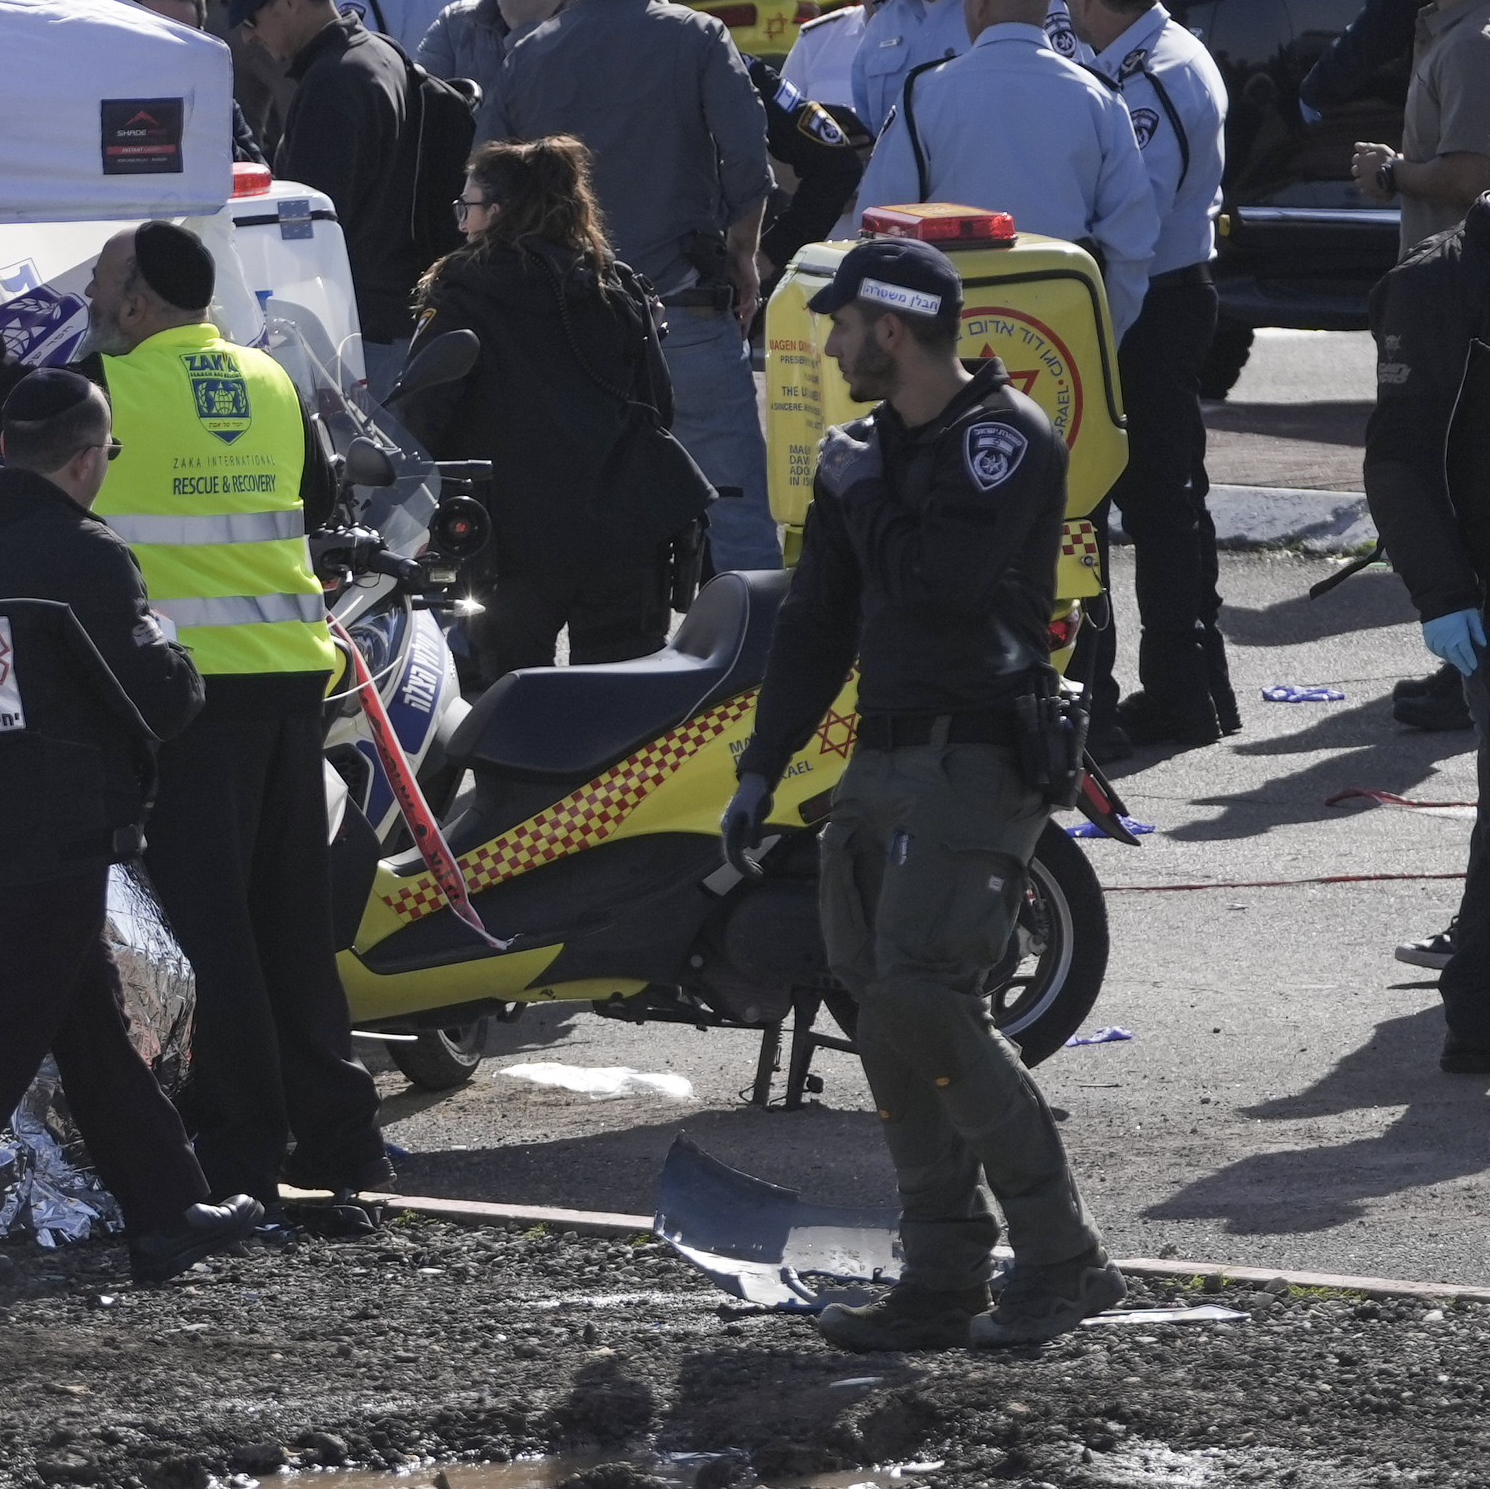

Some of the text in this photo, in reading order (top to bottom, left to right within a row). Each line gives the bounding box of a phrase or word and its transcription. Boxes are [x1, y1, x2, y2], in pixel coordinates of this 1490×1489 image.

[864, 283, 939, 311] חבלן משטרה
[968, 319, 1016, 337] אדום
[1019, 328, 1045, 351] דוד
[782, 386, 799, 397] THE
[173, 455, 276, 469] ZAKA INTERNATIONAL
[173, 473, 276, 495] RESCUE & RECOVERY
[402, 664, 437, 714] הצלה
